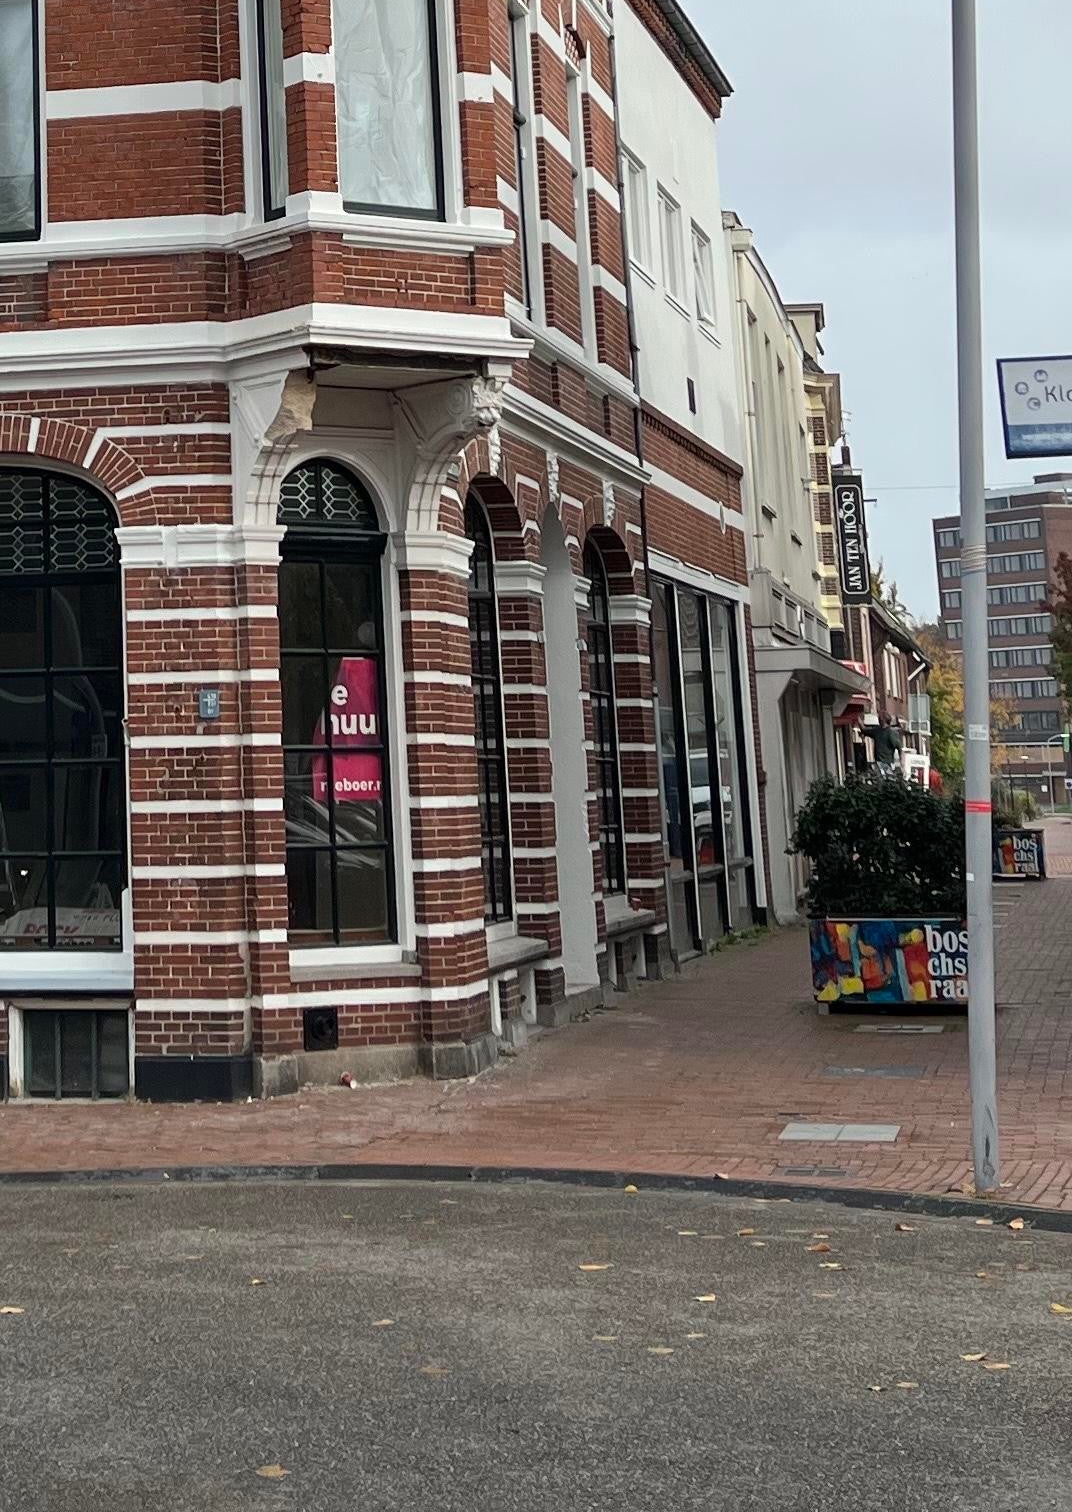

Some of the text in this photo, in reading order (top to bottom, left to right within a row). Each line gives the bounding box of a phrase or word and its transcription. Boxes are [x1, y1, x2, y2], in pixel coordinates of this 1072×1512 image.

[845, 538, 860, 563] TEN
[847, 566, 863, 590] JAN
[320, 707, 381, 735] huu
[1013, 835, 1038, 850] bos
[924, 924, 969, 954] bos
[928, 953, 969, 976] chs
[929, 979, 969, 999] raa
